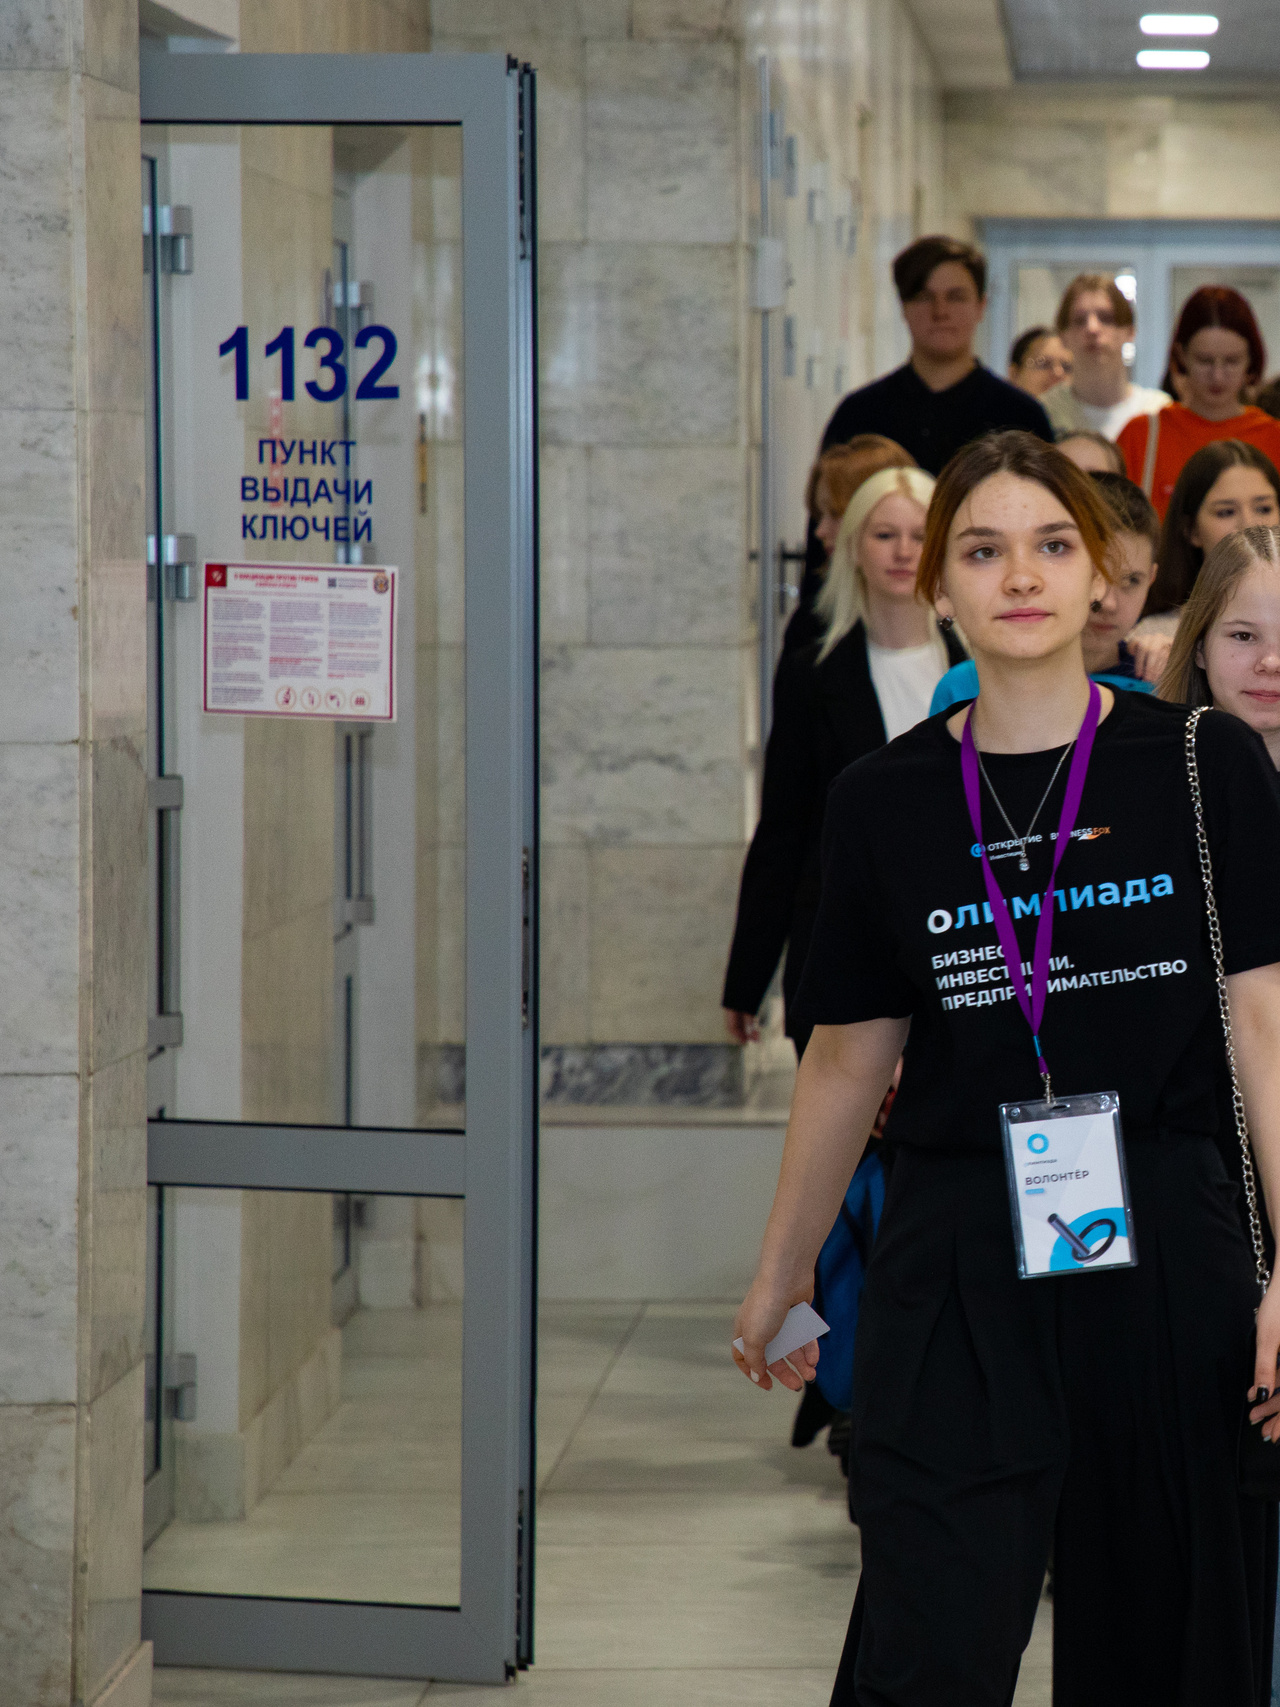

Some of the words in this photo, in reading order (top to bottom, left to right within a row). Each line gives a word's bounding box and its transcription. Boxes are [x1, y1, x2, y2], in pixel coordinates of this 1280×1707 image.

[219, 326, 400, 402] 1132
[258, 440, 357, 467] ПУНКТ
[240, 477, 373, 507] ВЫДАЧИ
[241, 511, 373, 543] КЛЮЧЕЙ
[987, 834, 1043, 853] открытие
[1050, 826, 1111, 841] BNESSFOX
[941, 959, 1188, 1011] ПРЕДПРИИМАТЕЛЬСТВО
[1025, 1169, 1090, 1186] ВОЛОНТЁР
